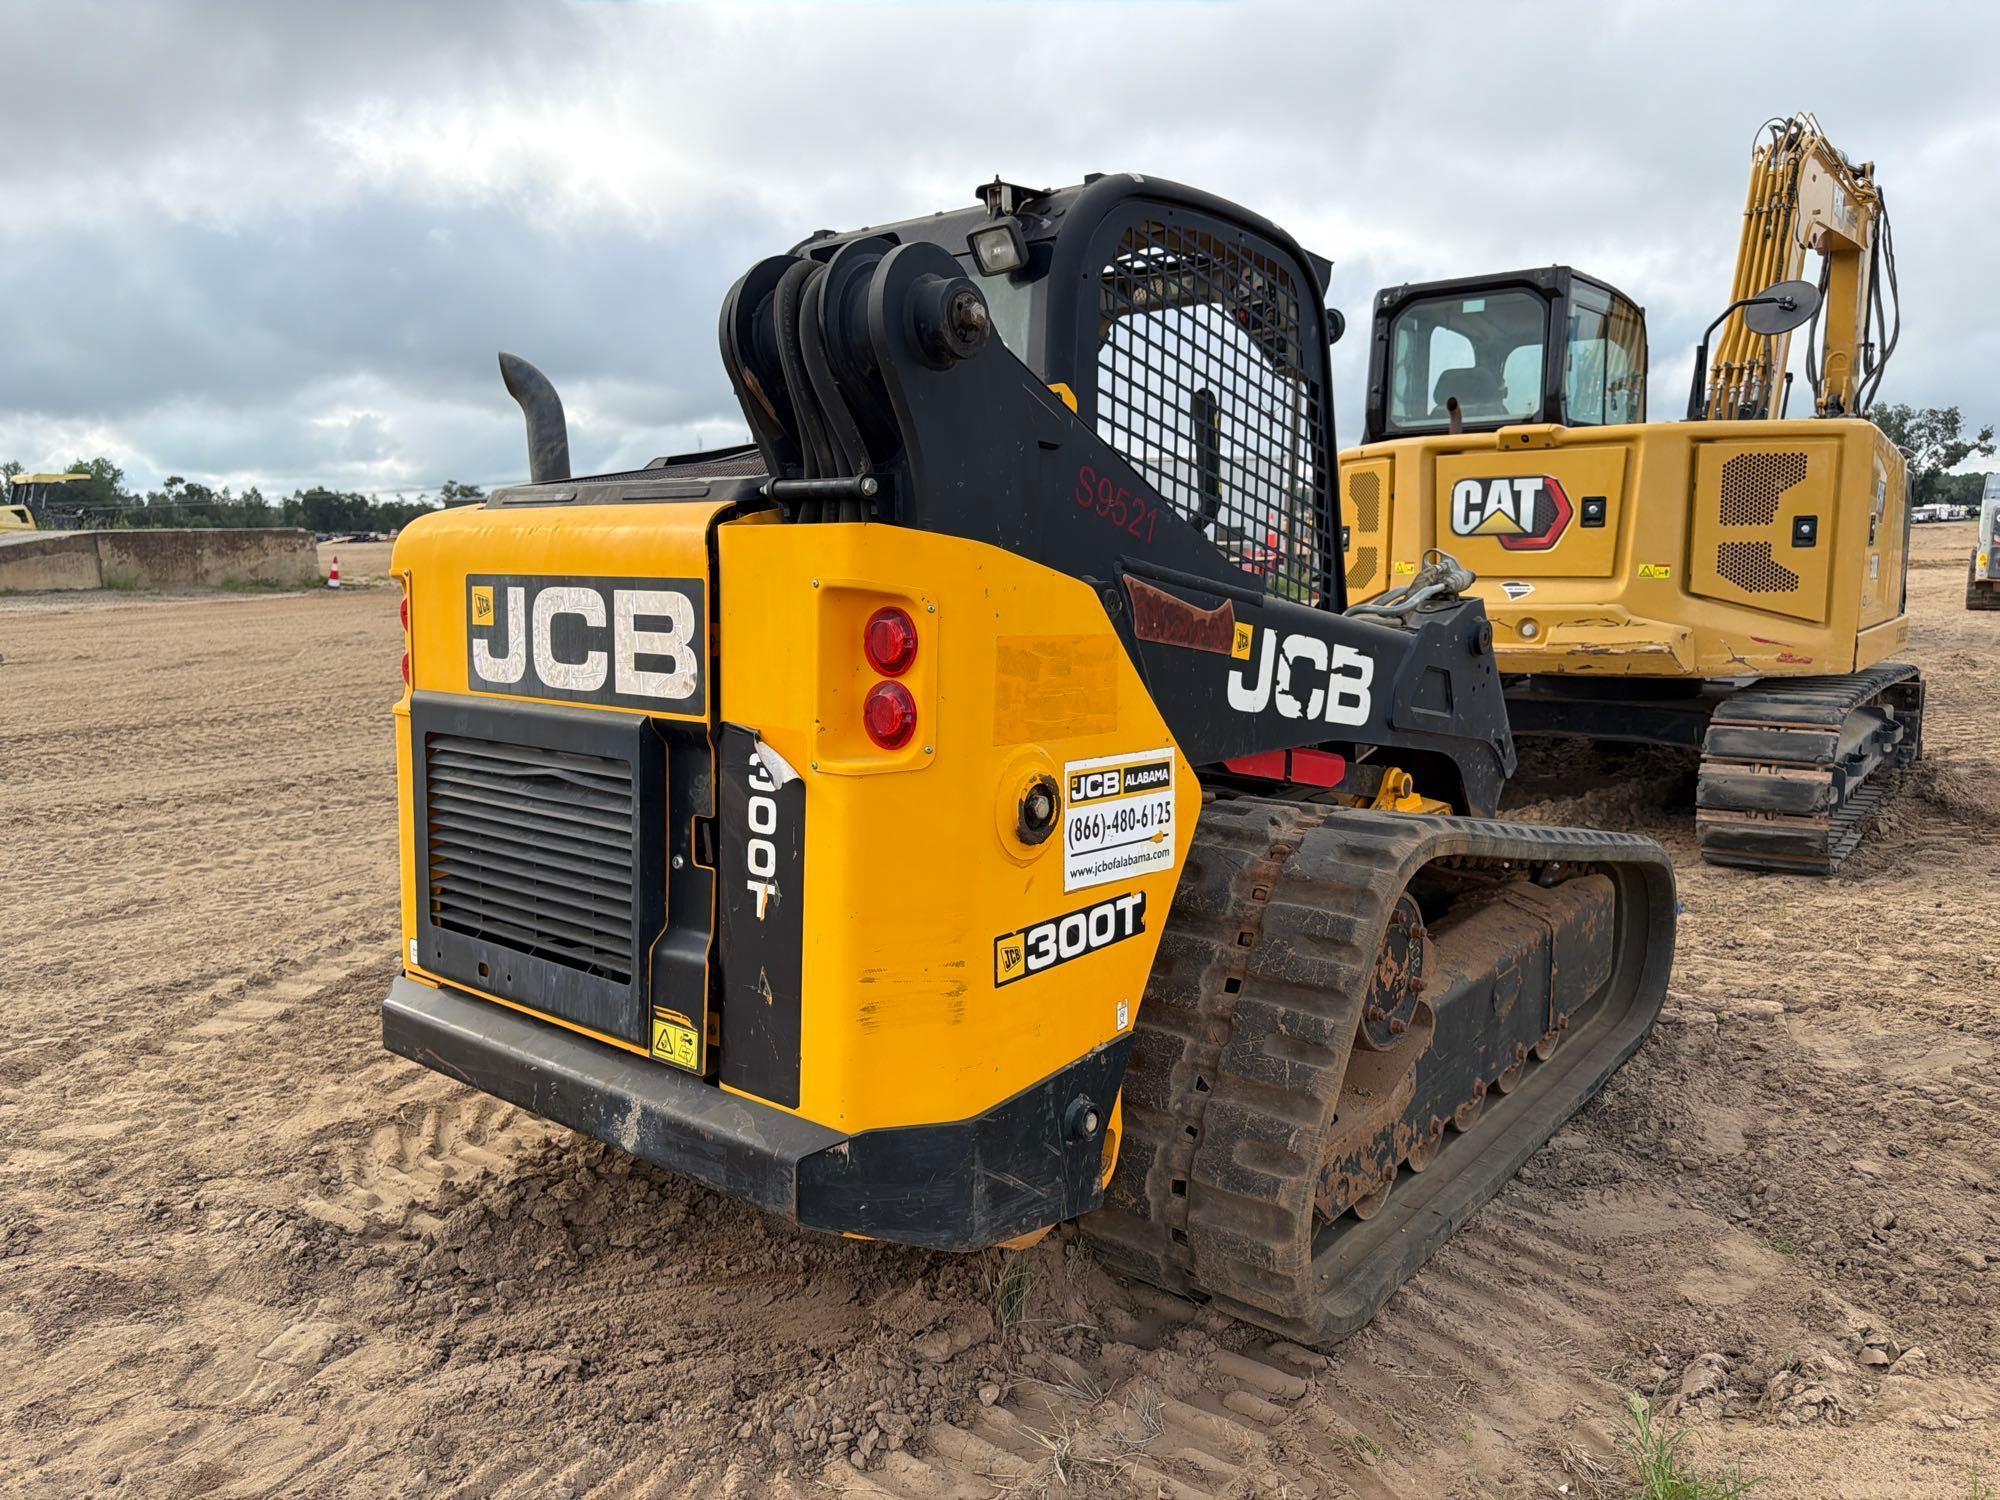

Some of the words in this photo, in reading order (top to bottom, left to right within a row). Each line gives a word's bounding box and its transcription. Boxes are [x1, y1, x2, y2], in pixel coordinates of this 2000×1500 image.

[1075, 466, 1157, 544] S9521
[1452, 478, 1543, 534] CAT
[473, 586, 697, 699] JCB
[1227, 628, 1374, 727] JCB
[1072, 771, 1120, 800] JCB
[1125, 768, 1169, 787] ALABAMA
[1069, 801, 1171, 850] (866)-480-6125
[1070, 848, 1170, 879] www.jcbofalabama.com
[1004, 948, 1022, 970] JCB
[1027, 893, 1142, 970] 300T
